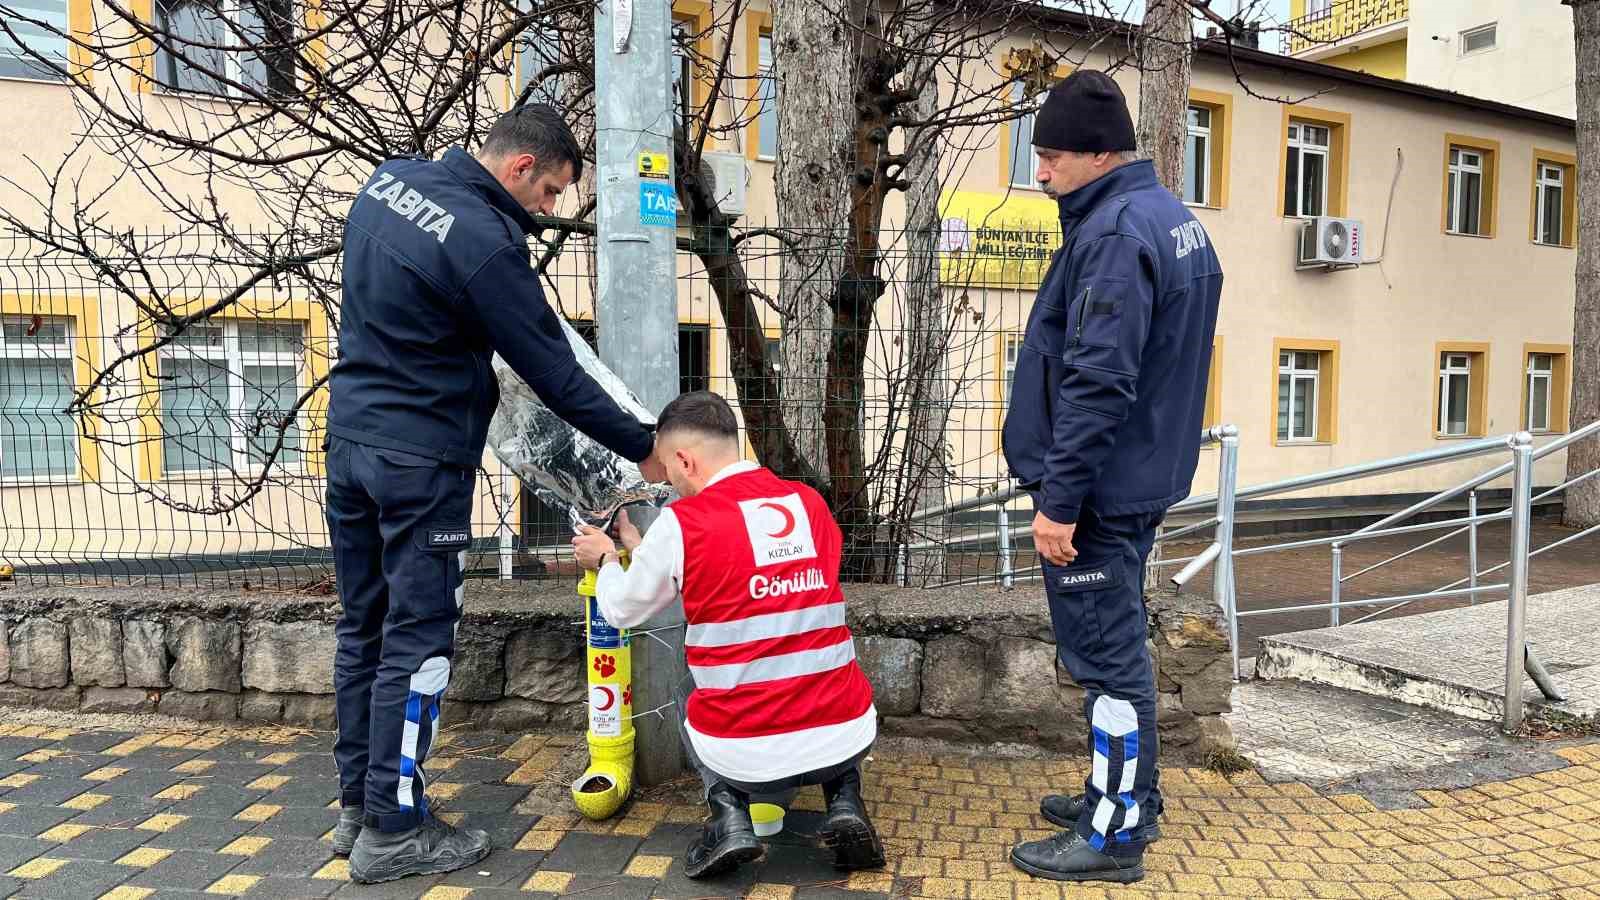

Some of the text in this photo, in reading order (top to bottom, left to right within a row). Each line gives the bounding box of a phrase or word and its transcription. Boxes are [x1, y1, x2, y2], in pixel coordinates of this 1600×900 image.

[366, 172, 455, 243] ZABITA
[976, 226, 1023, 244] BÜNYAN
[433, 533, 468, 542] ZABITA
[768, 545, 803, 560] KIZILAY
[749, 567, 829, 600] Gönüllü
[1062, 571, 1106, 584] ZABITA
